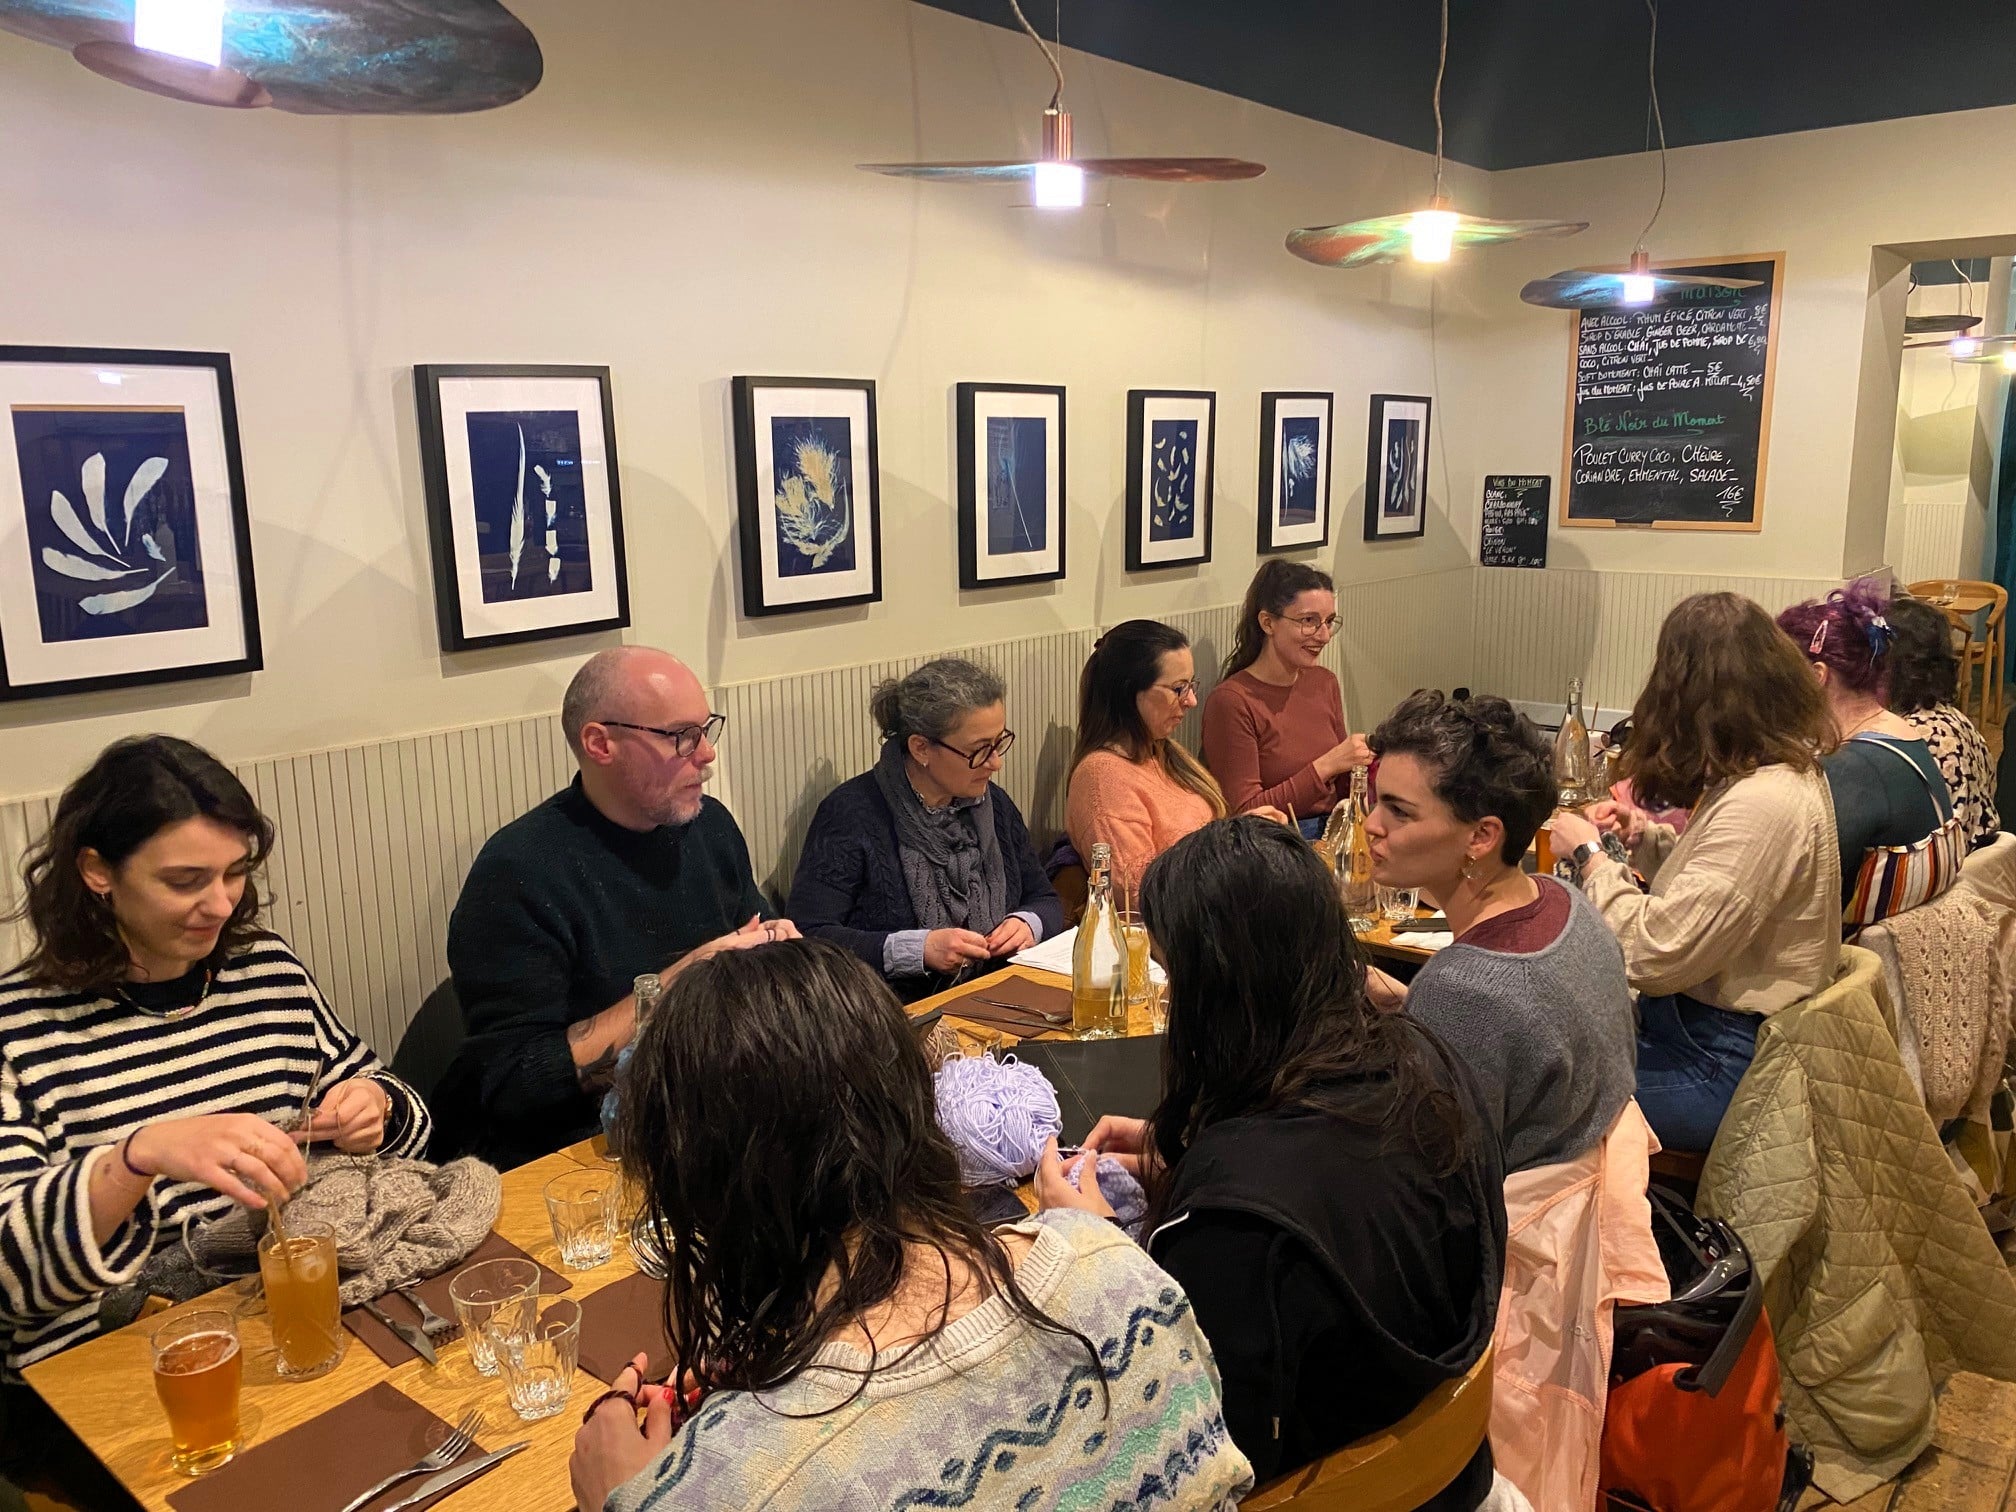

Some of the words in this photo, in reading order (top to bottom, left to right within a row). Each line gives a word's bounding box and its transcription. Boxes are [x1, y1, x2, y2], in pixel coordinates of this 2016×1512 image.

[1581, 317, 1599, 330] AVEC
[1600, 315, 1632, 326] ALCOOL:
[1633, 311, 1661, 324] RHUM
[1676, 323, 1700, 337] BEER,
[1578, 344, 1597, 355] SANS
[1599, 342, 1627, 353] ALCOOL:
[1670, 338, 1681, 348] DE
[1736, 333, 1749, 345] DE
[1578, 371, 1597, 383] SOFT
[1643, 363, 1663, 378] CHAÏ
[1665, 363, 1691, 376] LATTE
[1707, 361, 1724, 373] 5€
[1580, 359, 1600, 369] COCO,
[1591, 386, 1602, 396] du
[1656, 381, 1668, 390] DE
[1584, 412, 1610, 435] Blé
[1615, 410, 1648, 431] Noir
[1653, 416, 1669, 428] du
[1673, 411, 1726, 427] Moment
[1573, 443, 1617, 466] POULET
[1618, 448, 1648, 471] CURRY
[1681, 444, 1731, 464] CHÈVRE,
[1576, 469, 1625, 485] CORIANDRE,
[1628, 468, 1684, 484] EMMENTAL,
[1690, 468, 1735, 482] SALADE
[1716, 485, 1744, 500] 16€
